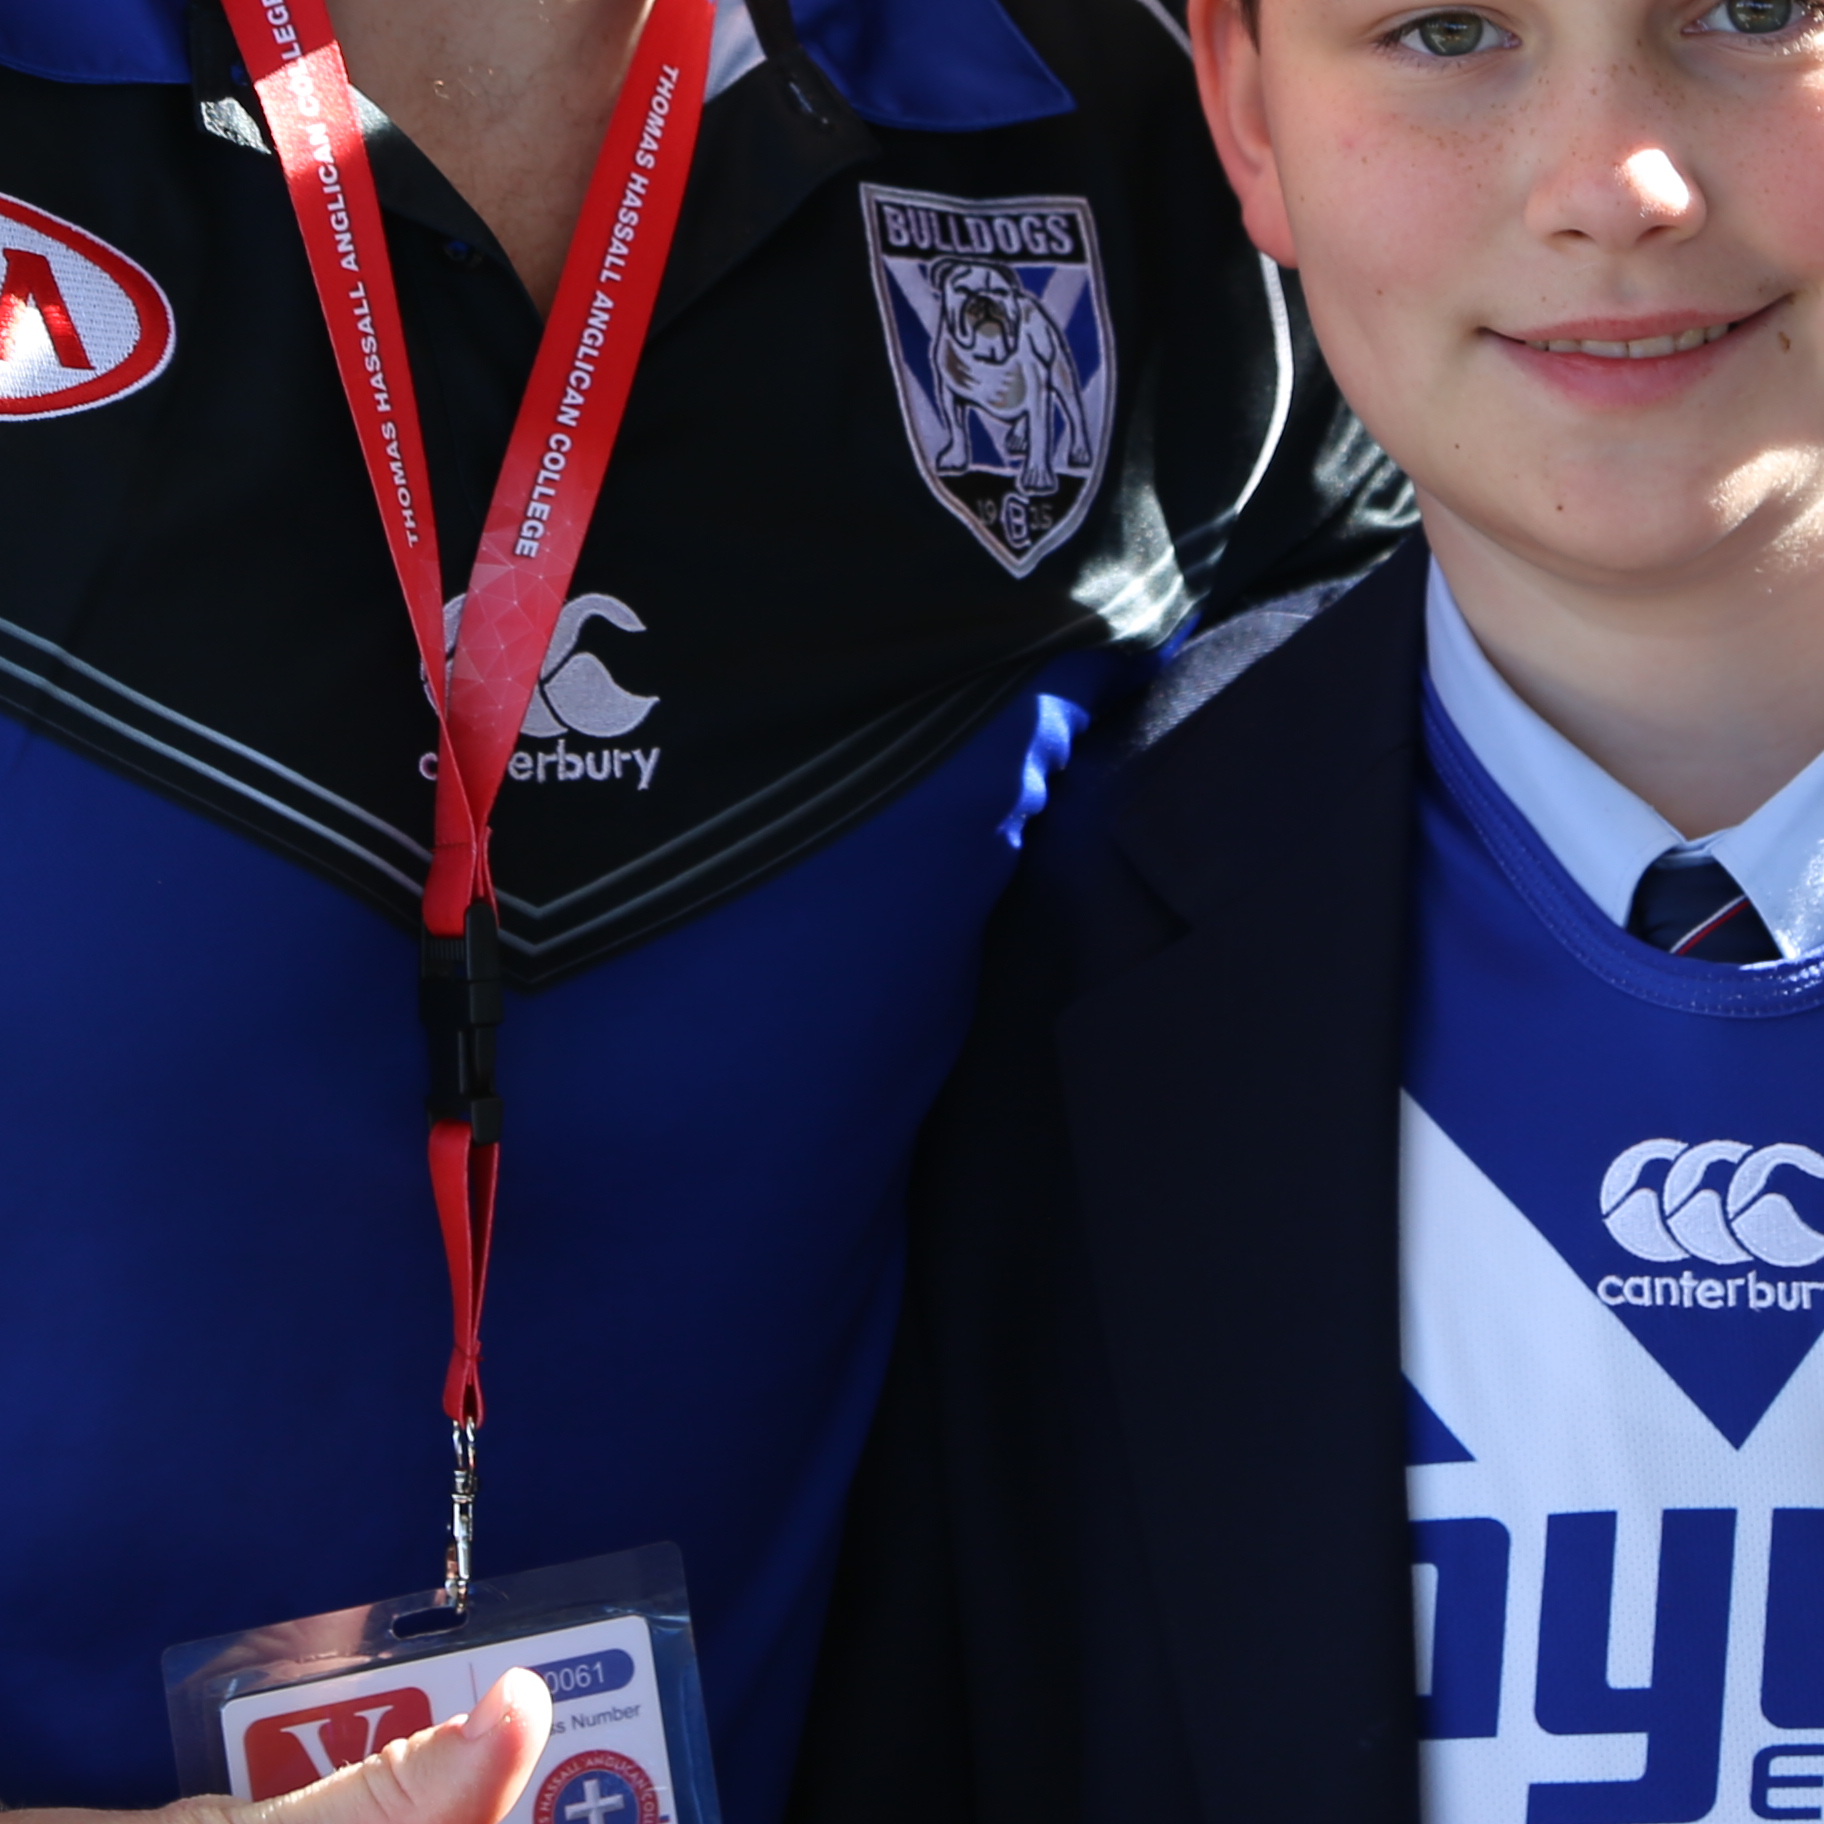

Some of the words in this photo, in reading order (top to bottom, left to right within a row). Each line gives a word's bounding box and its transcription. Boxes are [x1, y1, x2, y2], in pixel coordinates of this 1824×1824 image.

[635, 63, 680, 169] THOMAS
[307, 123, 359, 272] ANGLICAN
[600, 171, 649, 283] HASSALL
[882, 204, 1074, 255] BULLDOGS
[349, 281, 391, 412] HASSALL
[556, 289, 614, 428] ANGLICAN
[381, 421, 418, 547] THOMAS
[514, 432, 572, 559] COLLEGE
[419, 739, 660, 790] cerbury
[570, 1704, 640, 1730] Number
